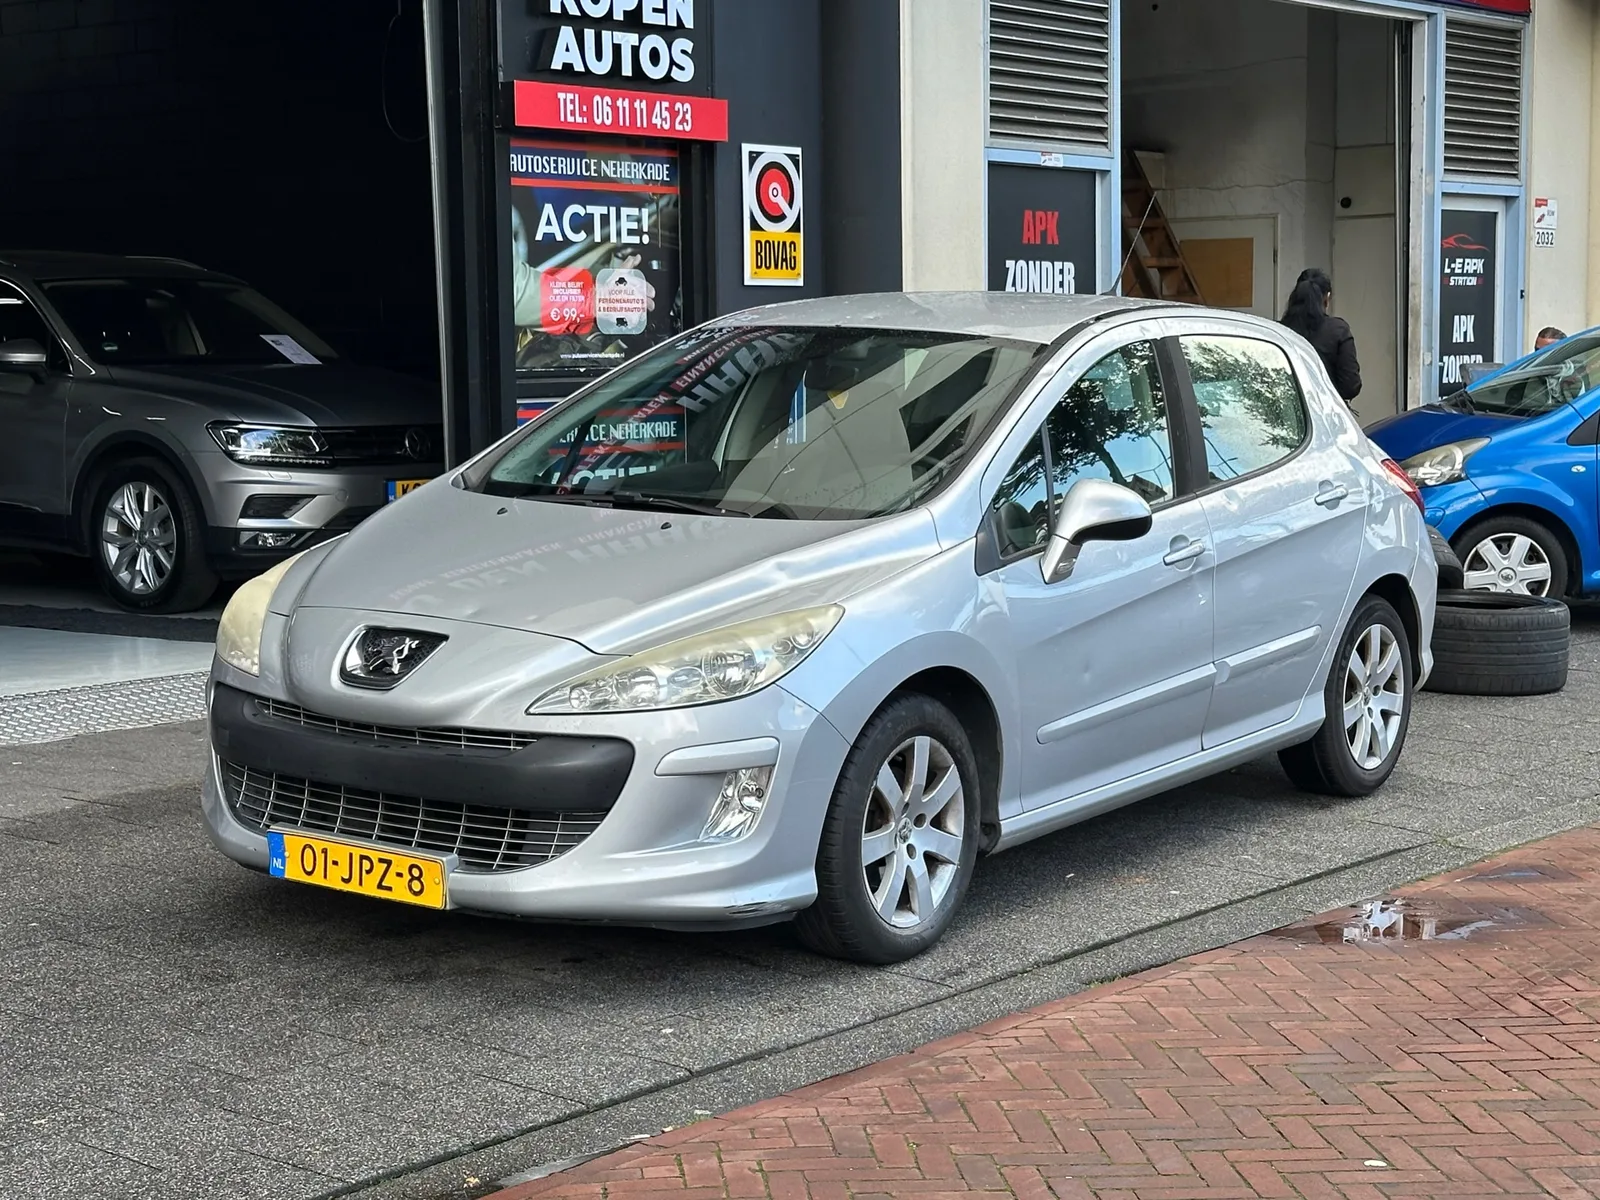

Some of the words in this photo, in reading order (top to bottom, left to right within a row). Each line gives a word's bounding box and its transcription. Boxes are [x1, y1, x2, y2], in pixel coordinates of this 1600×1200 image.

[549, 0, 694, 29] PEN
[550, 26, 695, 82] AUTOS
[557, 92, 587, 124] TEL:
[593, 95, 612, 126] 06
[616, 97, 630, 127] 11
[634, 99, 647, 128] 11
[651, 100, 670, 130] 45
[674, 102, 692, 132] 23
[510, 154, 598, 177] AUTOSERVICE
[601, 159, 670, 181] NEHERKADE
[535, 203, 650, 245] ACTIE!
[1022, 209, 1059, 245] APK
[1536, 231, 1554, 245] 2032
[755, 240, 797, 271] BOVAG
[1444, 257, 1463, 273] L-E
[1464, 258, 1485, 274] APK
[1005, 259, 1076, 295] ZONDER
[1449, 276, 1477, 286] STATION
[550, 308, 560, 321] €
[563, 308, 585, 323] 99,-
[1452, 315, 1475, 343] APK
[1442, 355, 1482, 384] ZON
[609, 421, 677, 441] NEHERKADE
[272, 857, 284, 870] NL
[300, 843, 425, 897] 01-JPZ-8
